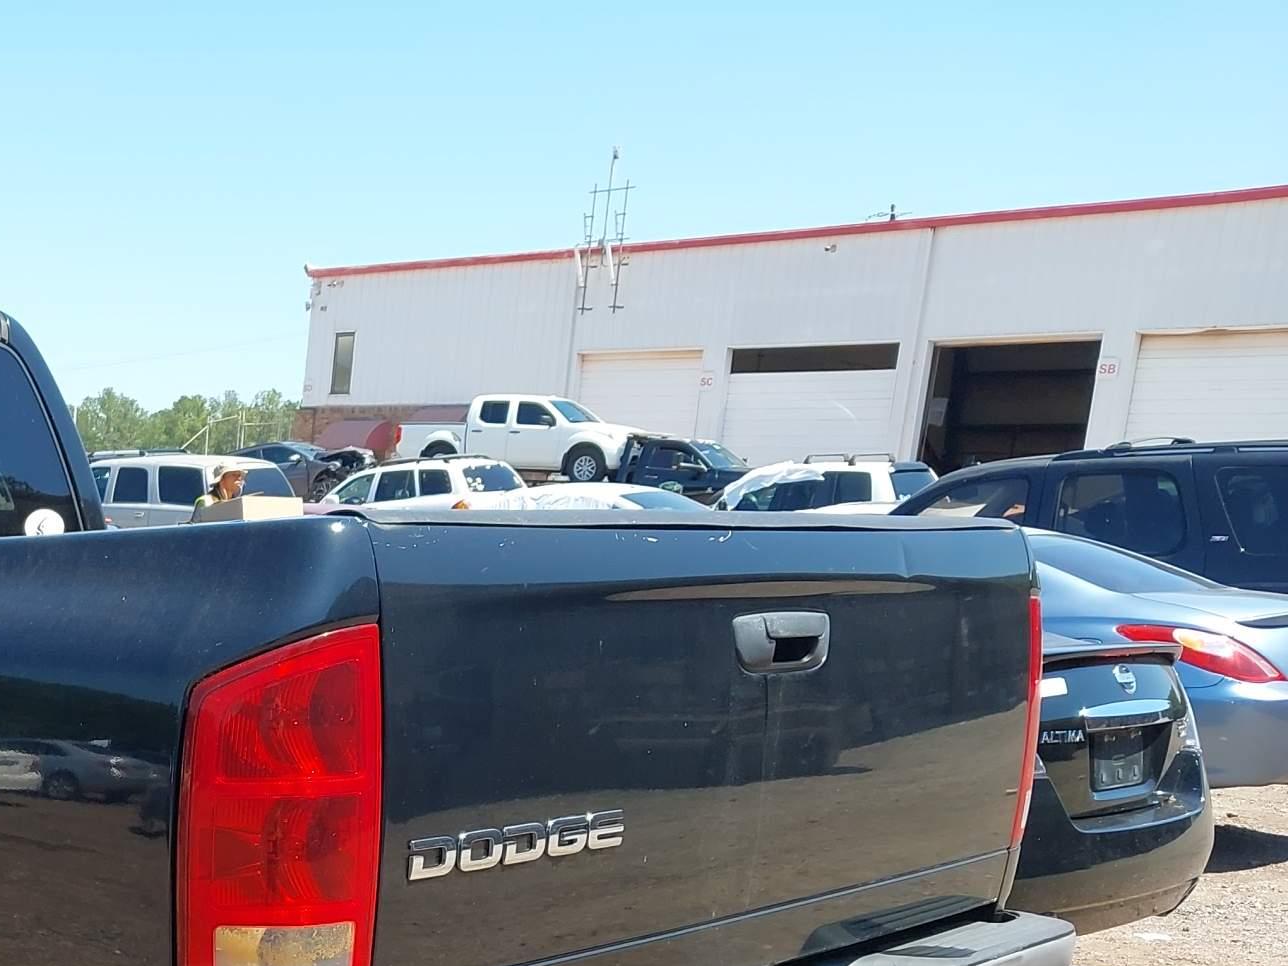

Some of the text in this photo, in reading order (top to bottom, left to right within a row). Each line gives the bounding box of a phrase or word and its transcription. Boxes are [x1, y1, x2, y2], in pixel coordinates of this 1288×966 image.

[1099, 363, 1116, 374] SB
[700, 377, 713, 386] SC
[1041, 729, 1085, 743] ALTIMA
[408, 808, 624, 881] DODGE
